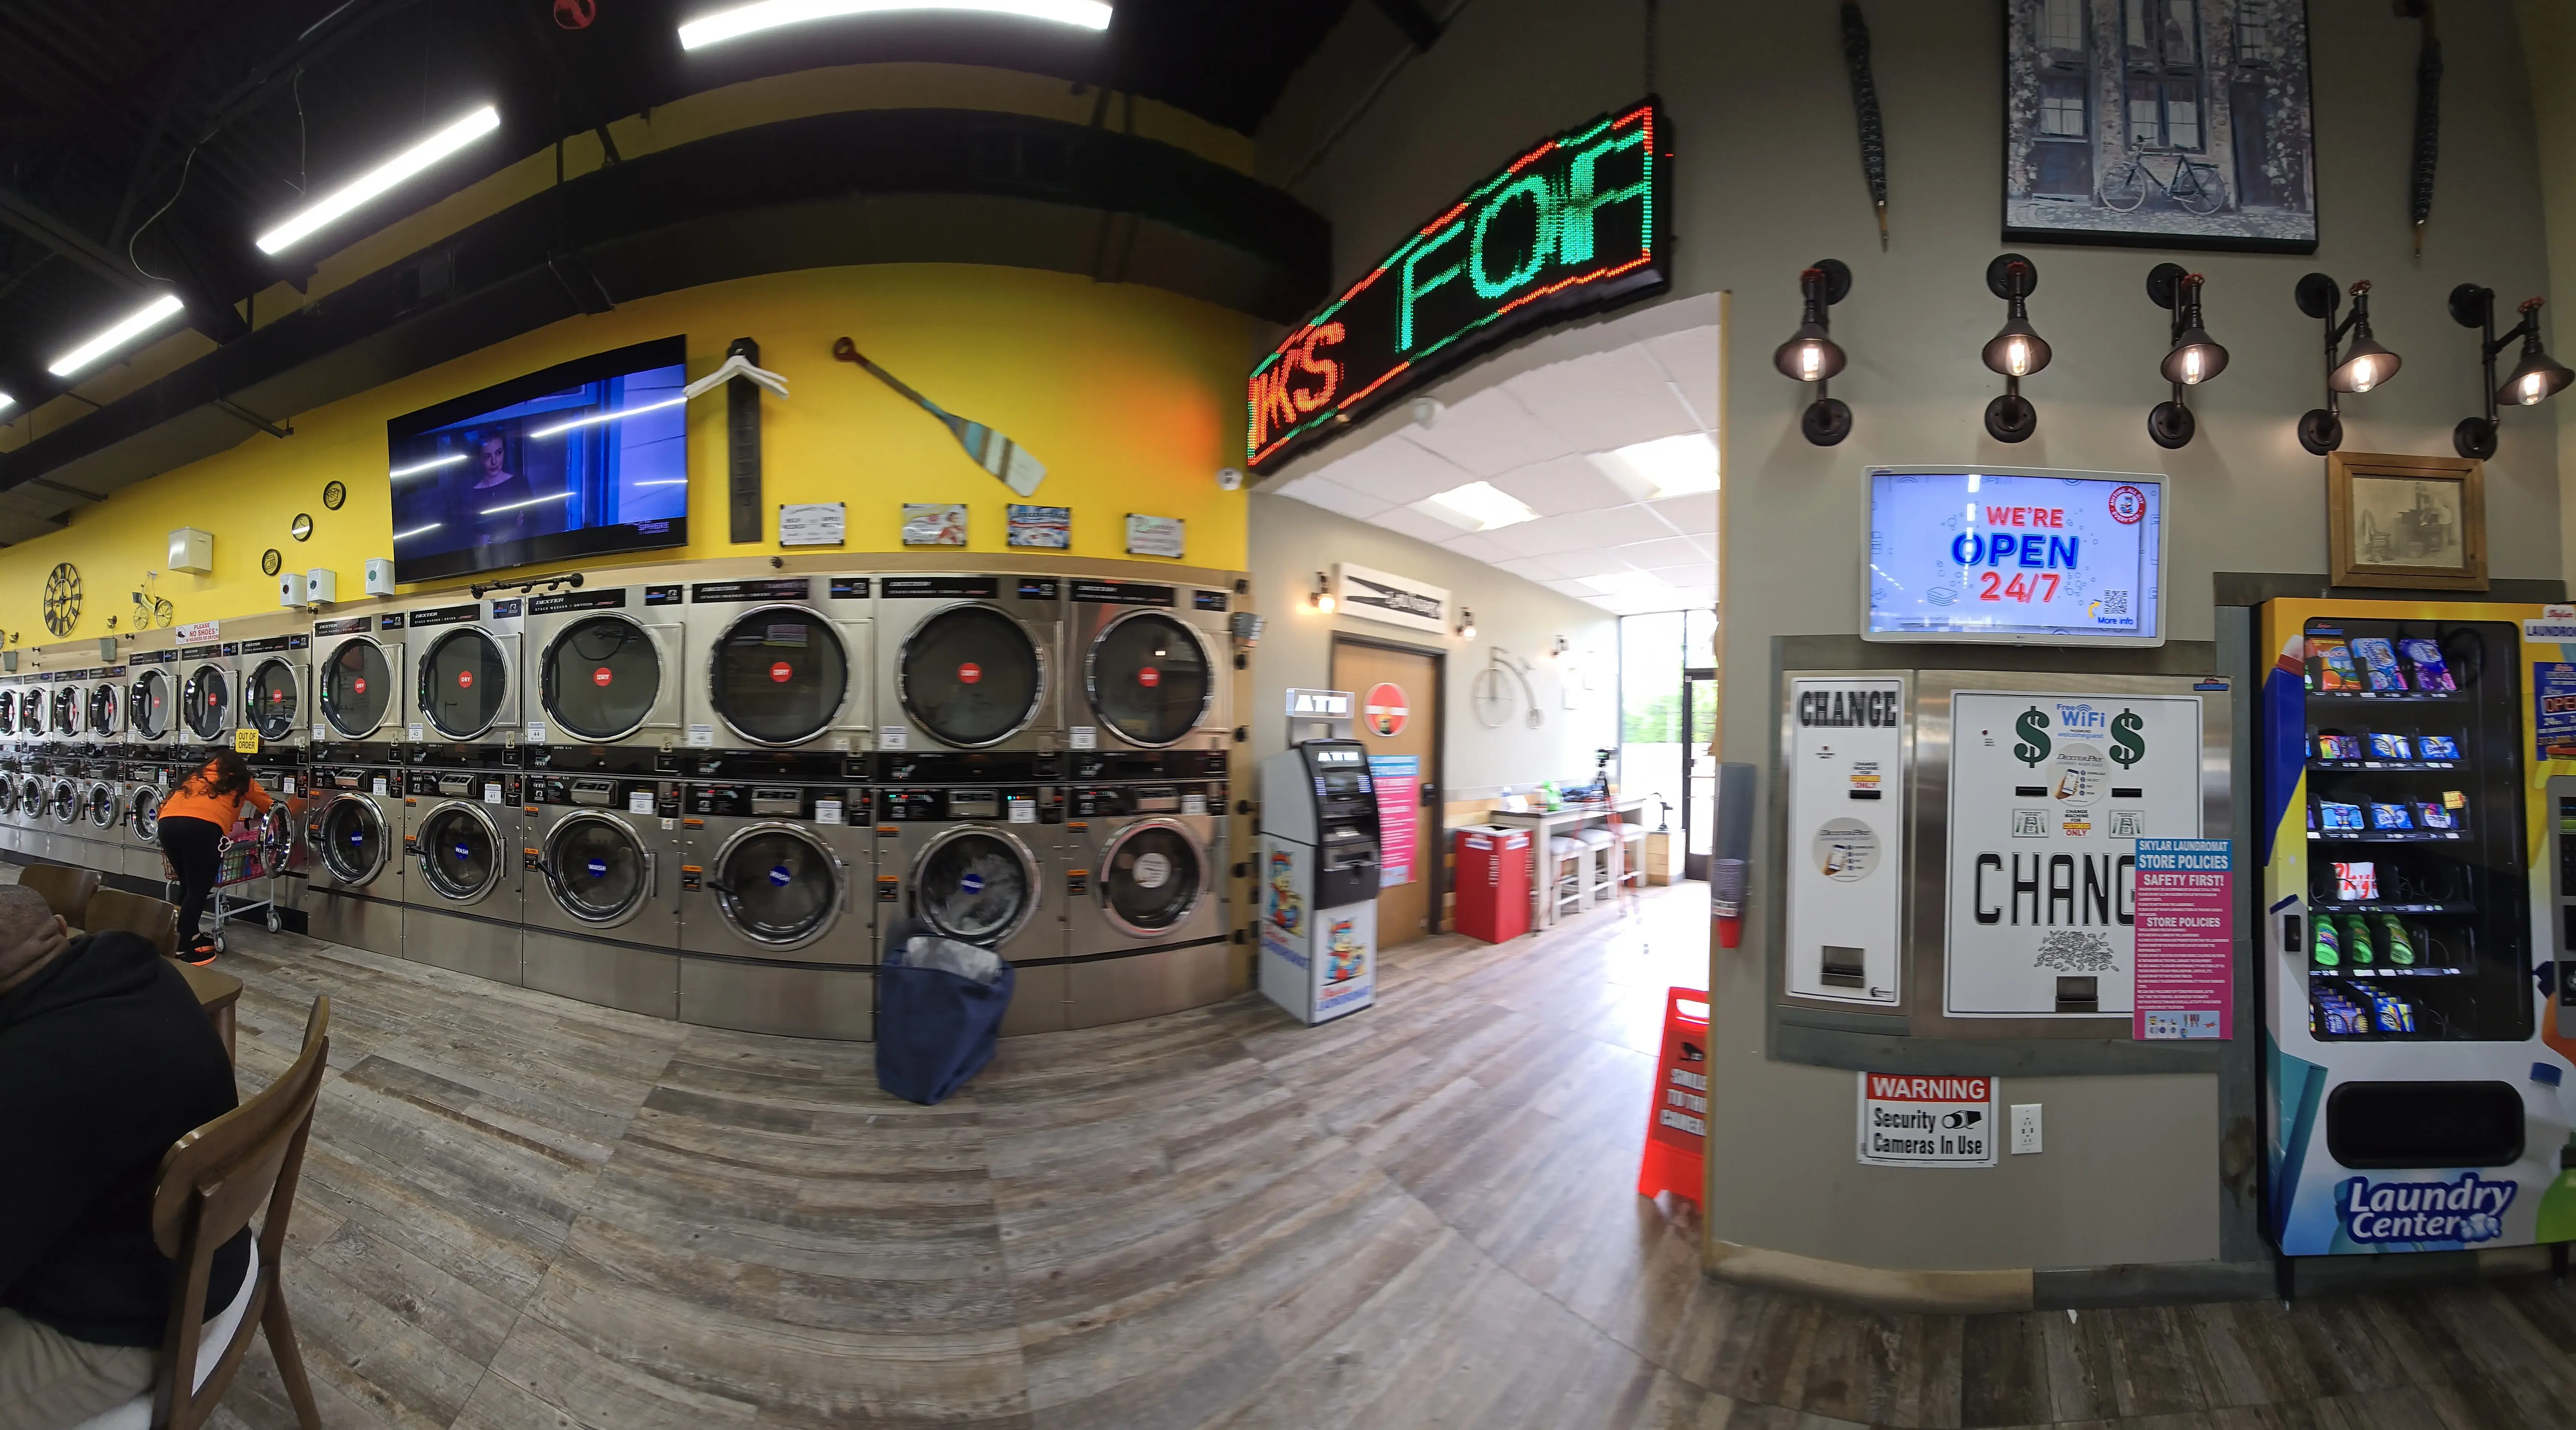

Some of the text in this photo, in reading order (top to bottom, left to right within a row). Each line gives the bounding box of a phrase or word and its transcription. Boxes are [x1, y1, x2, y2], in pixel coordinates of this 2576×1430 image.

[1986, 505, 2064, 528] WE'RE
[1952, 533, 2079, 569] OPEN
[1980, 571, 2061, 603] 24/7
[535, 597, 564, 605] DEXTER
[2097, 617, 2118, 625] More
[197, 627, 215, 636] SHOES
[2057, 703, 2077, 711] Free
[2061, 711, 2106, 728] WiFi
[239, 732, 249, 740] OUT
[239, 741, 256, 749] ORDER
[455, 847, 469, 855] WASH
[2138, 840, 2229, 851] SKYLAR LAUNDROMAT
[2138, 854, 2229, 869] STORE POLICIES
[2143, 874, 2225, 886] SAFETY FIRST!
[1974, 852, 2135, 926] CHANG
[2146, 917, 2221, 927] STORE POLICIES
[1872, 1077, 1986, 1100] WARNING
[1873, 1107, 1936, 1134] Security
[1873, 1132, 1983, 1155] Cameras In Use
[2349, 1177, 2513, 1217] Laundry
[2351, 1212, 2461, 1239] Center
